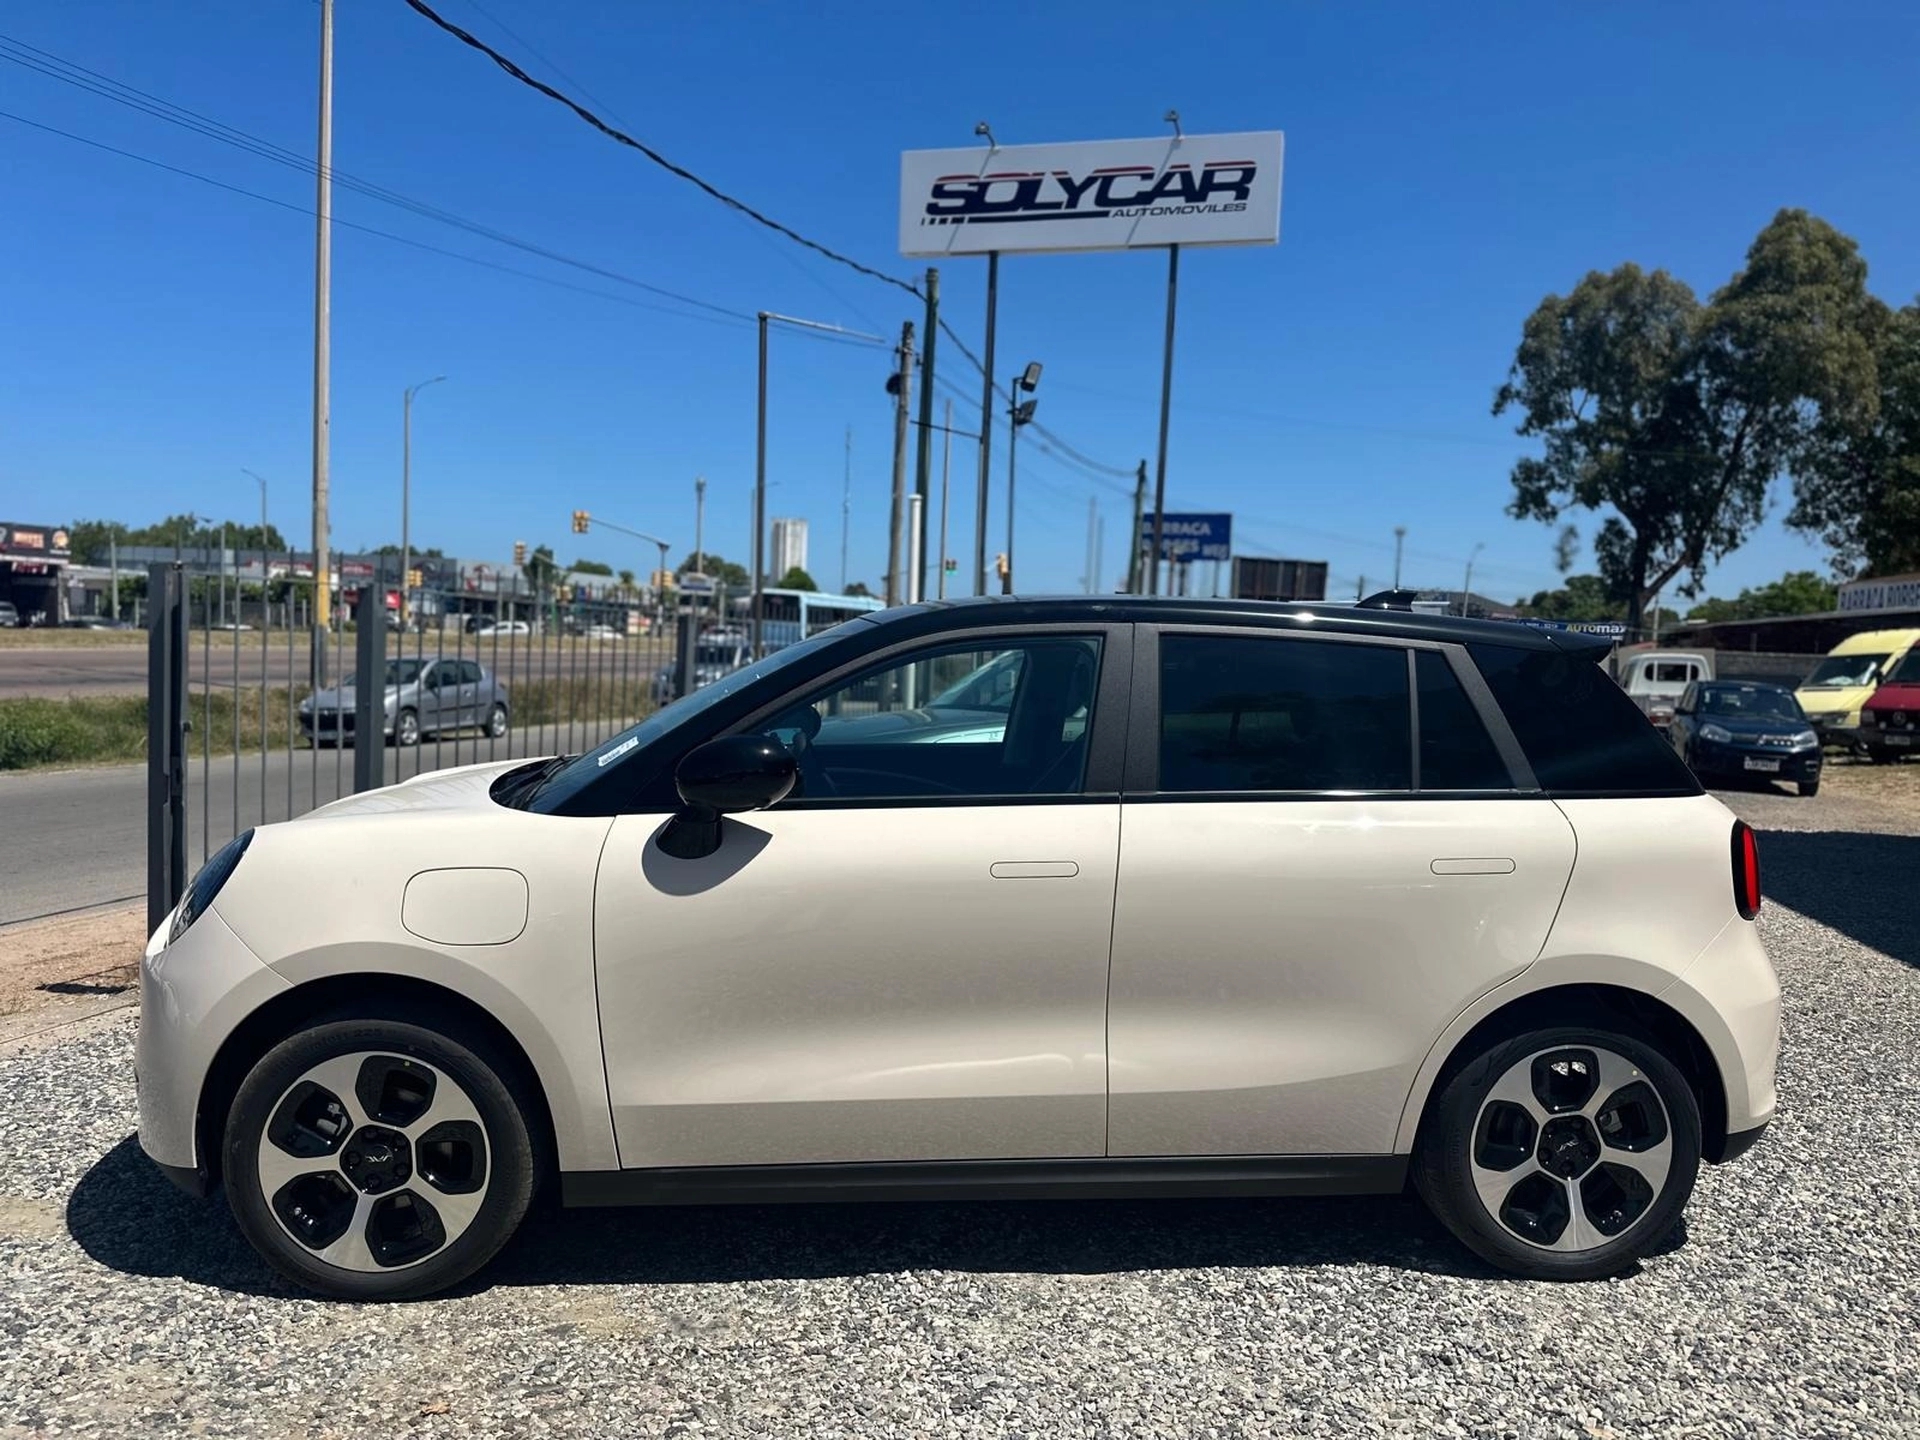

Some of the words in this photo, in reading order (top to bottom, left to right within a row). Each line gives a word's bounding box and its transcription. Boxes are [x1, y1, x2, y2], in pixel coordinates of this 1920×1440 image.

[925, 160, 1256, 216] SOLYCAR
[1112, 202, 1247, 218] AUTOMOVILES
[1143, 522, 1211, 536] BRRACA
